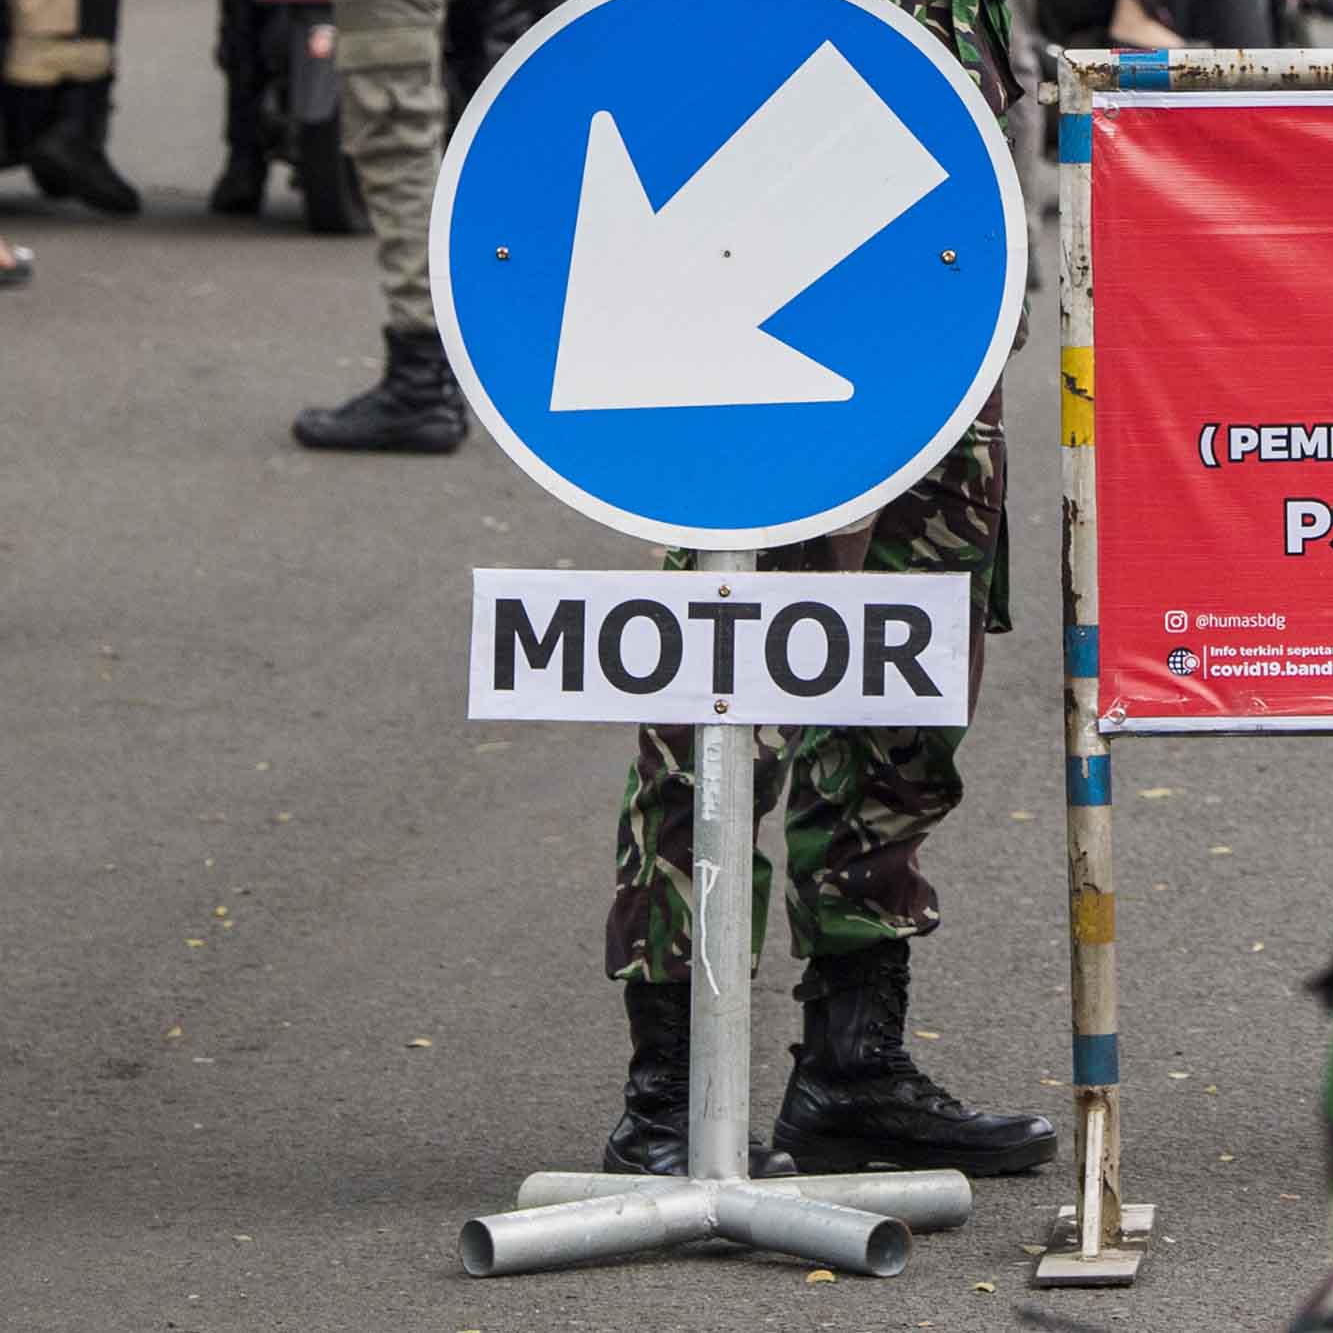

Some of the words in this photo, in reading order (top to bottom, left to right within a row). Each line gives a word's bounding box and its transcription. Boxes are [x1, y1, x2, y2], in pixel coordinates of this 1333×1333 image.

[1195, 613, 1287, 630] @humasbdg
[493, 598, 944, 698] MOTOR
[1210, 645, 1237, 657] Info
[1240, 645, 1284, 656] terkini
